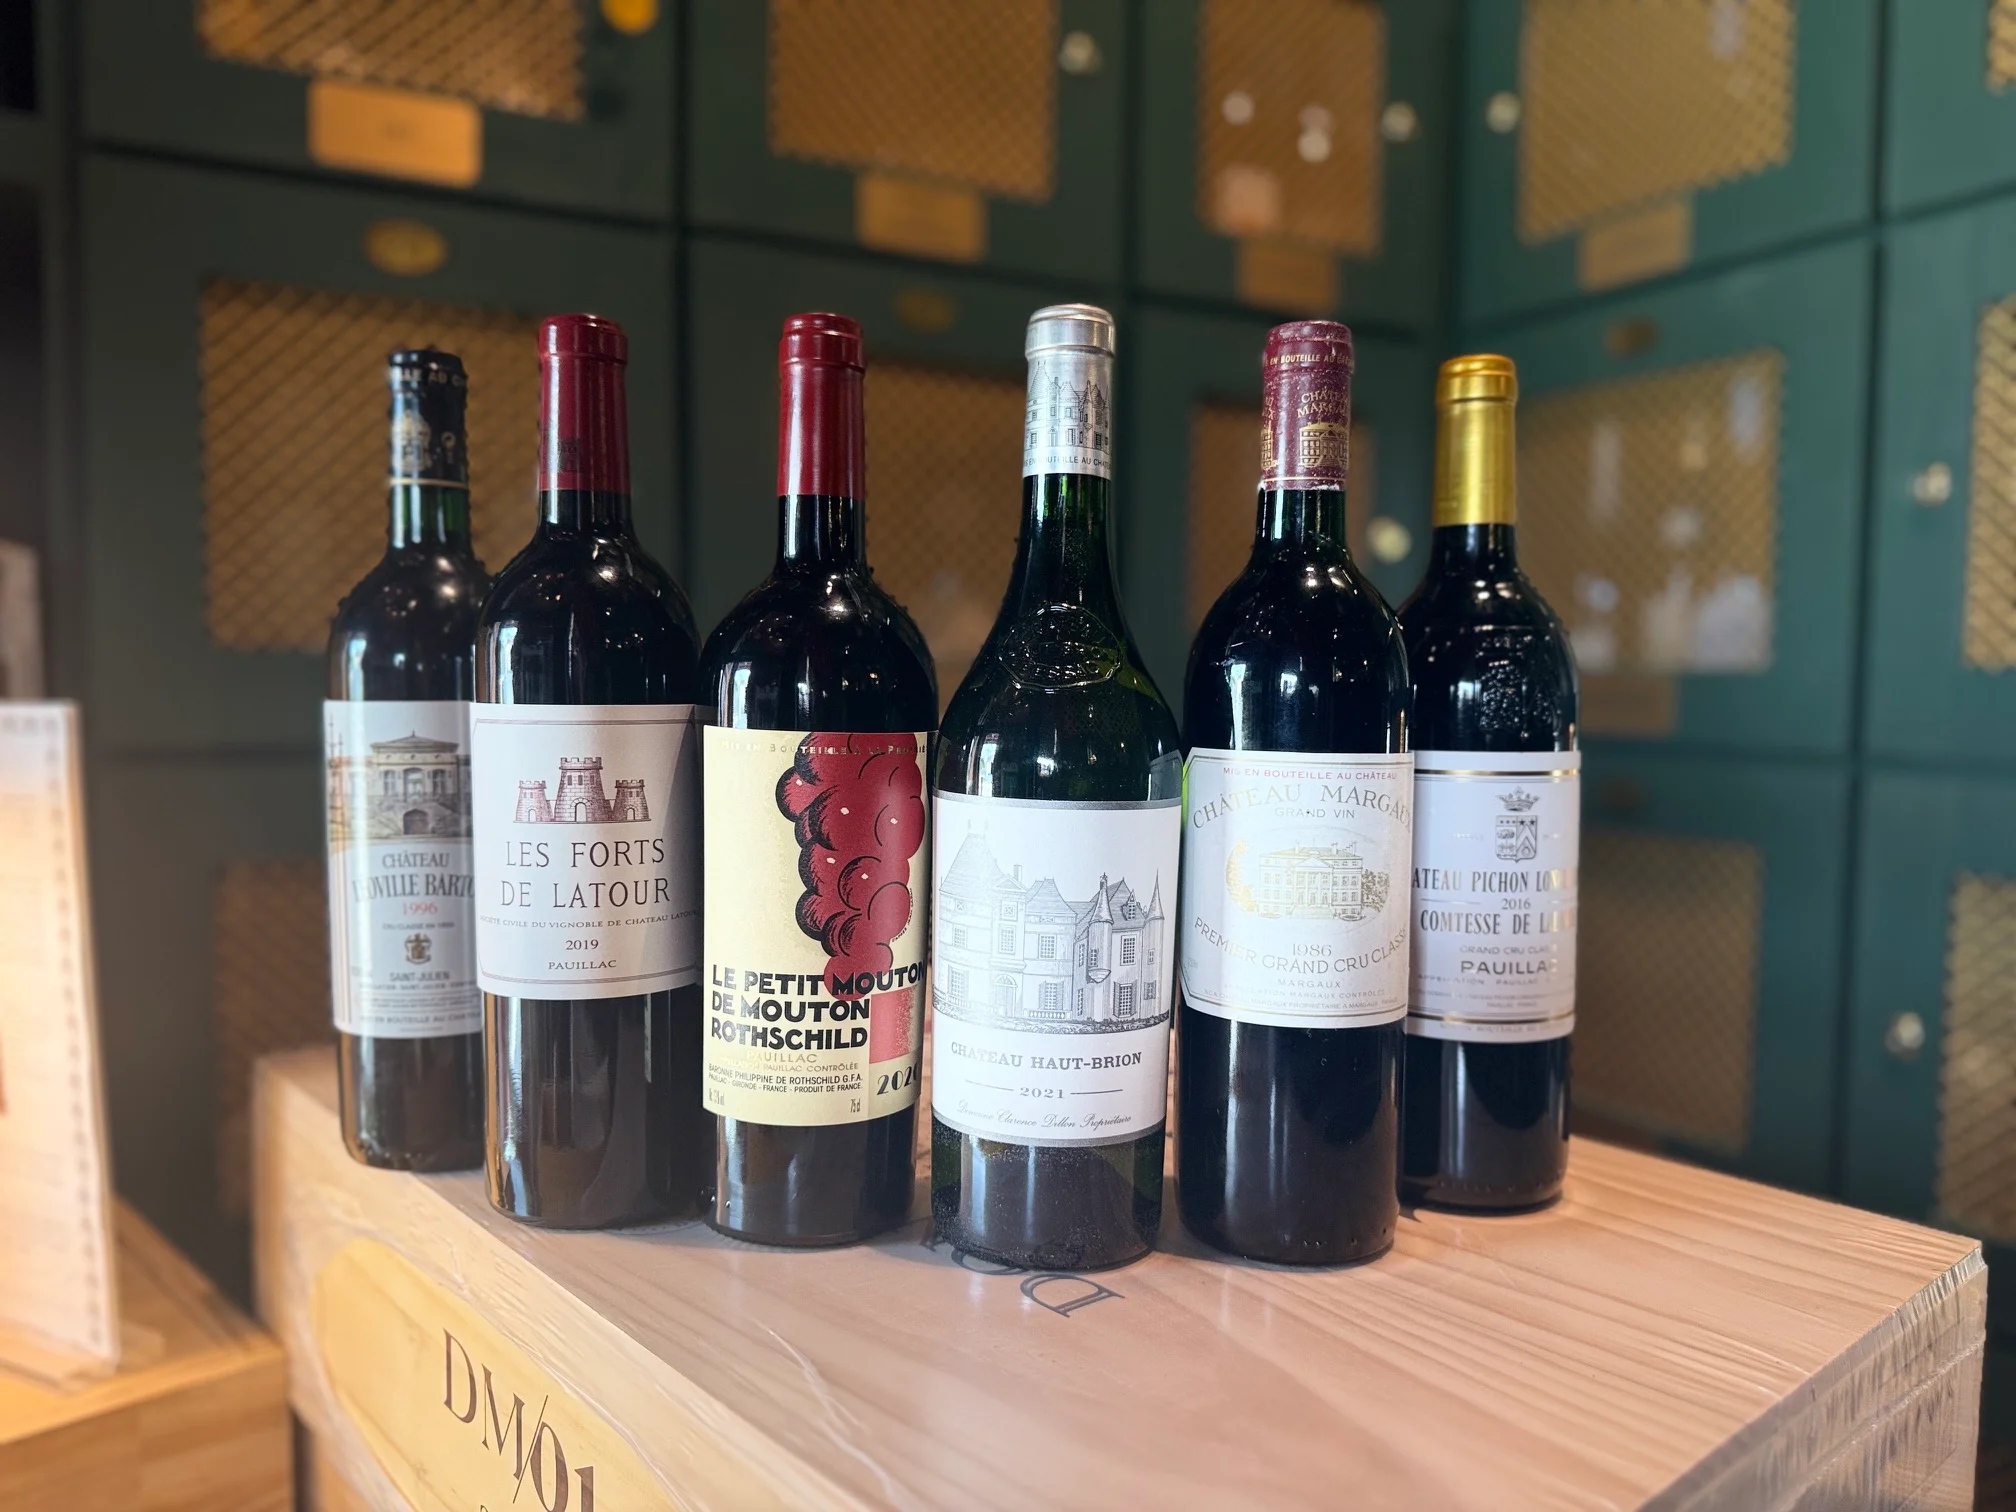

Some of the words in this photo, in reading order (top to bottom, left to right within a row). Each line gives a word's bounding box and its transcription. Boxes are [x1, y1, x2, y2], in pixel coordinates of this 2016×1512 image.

[1280, 353, 1321, 365] BOUTEILLE
[1081, 456, 1091, 465] AU
[1223, 766, 1241, 776] MIS
[1245, 767, 1260, 777] EN
[1264, 769, 1332, 780] BOUTEILLE
[1336, 771, 1352, 780] AU
[1355, 769, 1398, 781] CHÂTEAU
[1193, 783, 1302, 829] CHÂTEAU
[1274, 806, 1326, 819] GRAND
[1333, 808, 1356, 820] VIN
[382, 851, 450, 870] CHÂTEAU
[506, 841, 550, 869] LES
[570, 838, 666, 869] FORTS
[1472, 871, 1529, 893] PICHON
[500, 880, 532, 908] DE
[553, 877, 671, 909] LATOUR
[402, 901, 438, 917] 1996
[1501, 898, 1532, 910] 2016
[502, 919, 529, 928] CIVILE
[531, 921, 547, 929] DU
[548, 920, 606, 929] VIGNOBLE
[607, 918, 622, 928] DE
[625, 914, 669, 926] CHATEAU
[1420, 909, 1501, 935] COMTESSE
[1512, 913, 1531, 935] DE
[565, 938, 599, 950] 2019
[1194, 916, 1257, 965] PREMIER
[1261, 954, 1330, 975] GRAND
[1333, 952, 1370, 973] CRU
[1291, 942, 1333, 957] 1986
[1459, 945, 1500, 955] GRAND
[1503, 946, 1524, 955] CRU
[548, 959, 618, 971] PAUILLAC
[1460, 958, 1558, 976] PAUILLAC
[711, 964, 737, 991] LE
[743, 971, 825, 996] PETIT
[831, 962, 927, 996] MOUTON
[1277, 978, 1341, 989] MARGAUX
[1496, 977, 1539, 986] PAUILLAC
[1289, 990, 1336, 999] MARGAUX
[711, 990, 736, 1017] DE
[739, 996, 872, 1025] MOUTON
[711, 1017, 869, 1052] ROTHSCHILD
[746, 1051, 818, 1064] PAUILLAC
[950, 1041, 1023, 1069] CHATEAU
[1030, 1051, 1143, 1071] HAUT-BRION
[708, 1062, 734, 1078] BARONNE
[734, 1070, 774, 1084] PHILIPPINE
[776, 1075, 787, 1085] DE
[789, 1075, 841, 1086] ROTHSCHILD
[842, 1073, 864, 1083] G.F.A.
[763, 1063, 802, 1073] PAUILLAC
[806, 1061, 859, 1073] CONTRÔLÉE
[708, 1072, 727, 1084] PAUILLAC
[732, 1079, 758, 1091] GIRONDE
[762, 1084, 788, 1093] FRANCE
[794, 1085, 824, 1093] PRODUIT
[826, 1084, 835, 1092] DE
[1019, 1086, 1065, 1099] 2021
[995, 1110, 1038, 1128] Clarence
[1040, 1113, 1076, 1129] Dillon
[1079, 1111, 1132, 1130] Propriétaire
